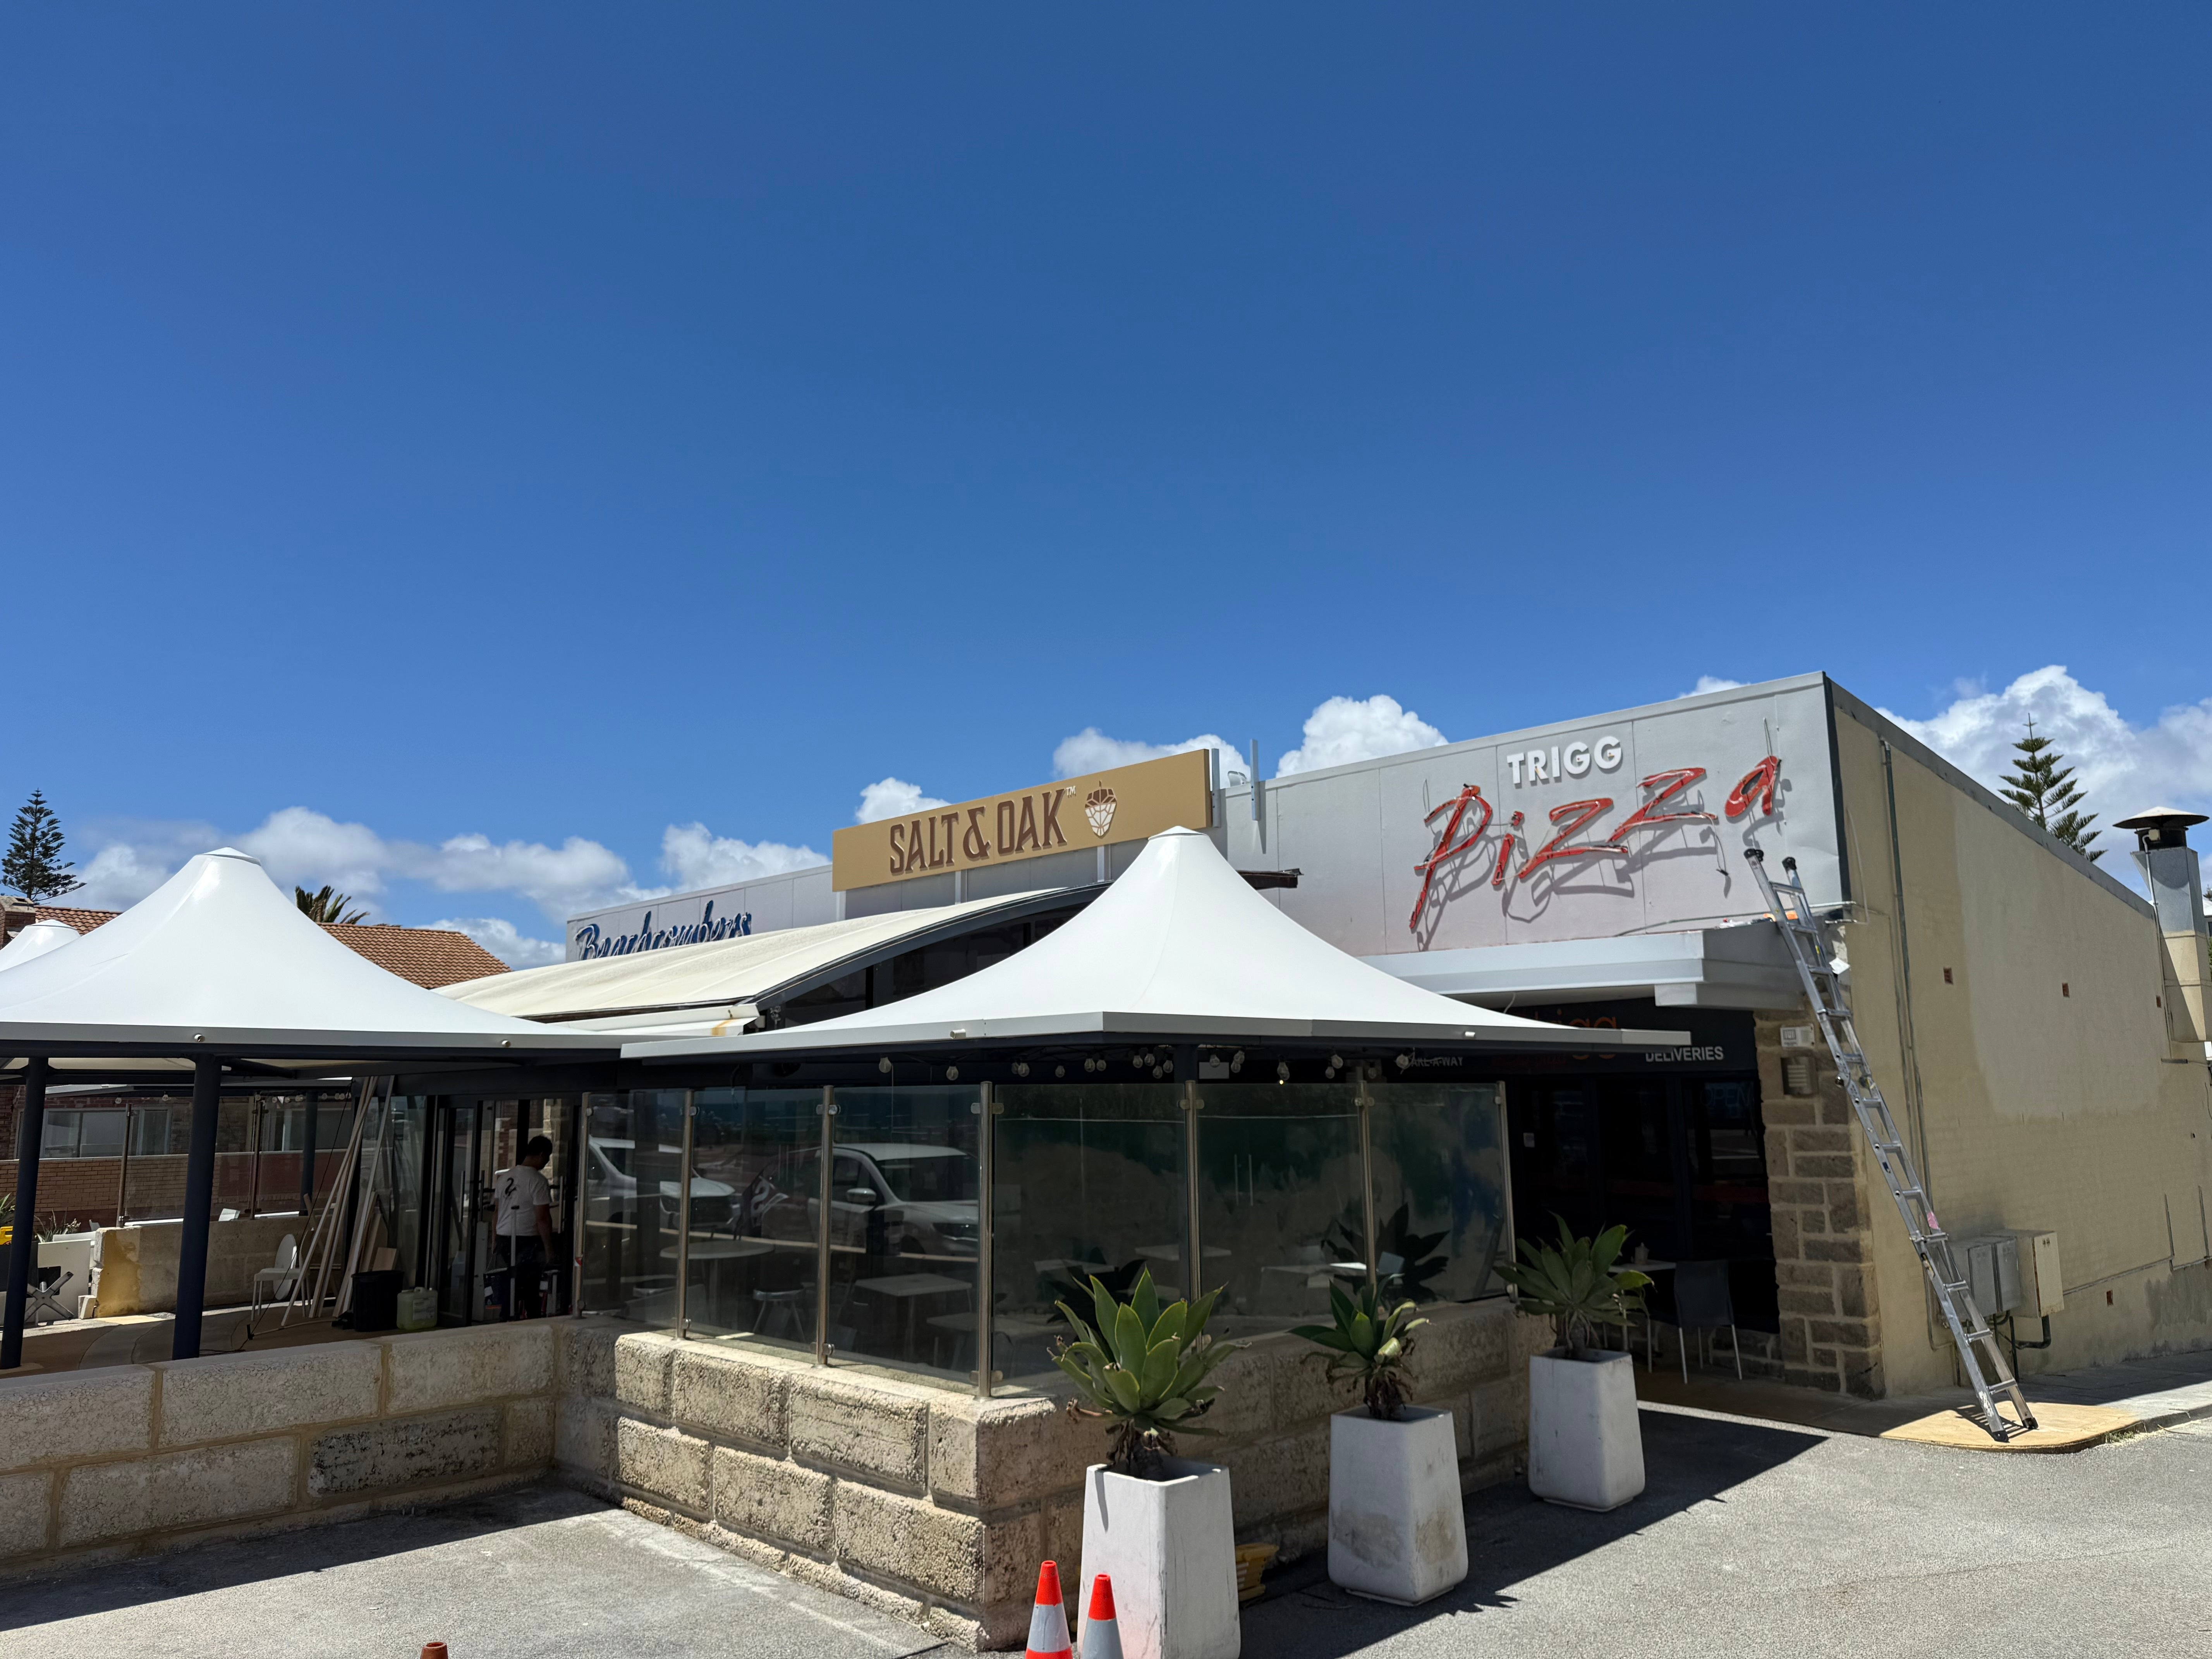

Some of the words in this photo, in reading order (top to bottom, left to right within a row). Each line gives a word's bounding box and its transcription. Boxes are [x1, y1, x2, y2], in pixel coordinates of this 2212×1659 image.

[1507, 735, 1623, 785] TRIGG
[890, 812, 959, 874] SALT
[963, 805, 991, 859] &
[997, 788, 1067, 855] OAK
[1645, 1046, 1725, 1062] DELIVERIES
